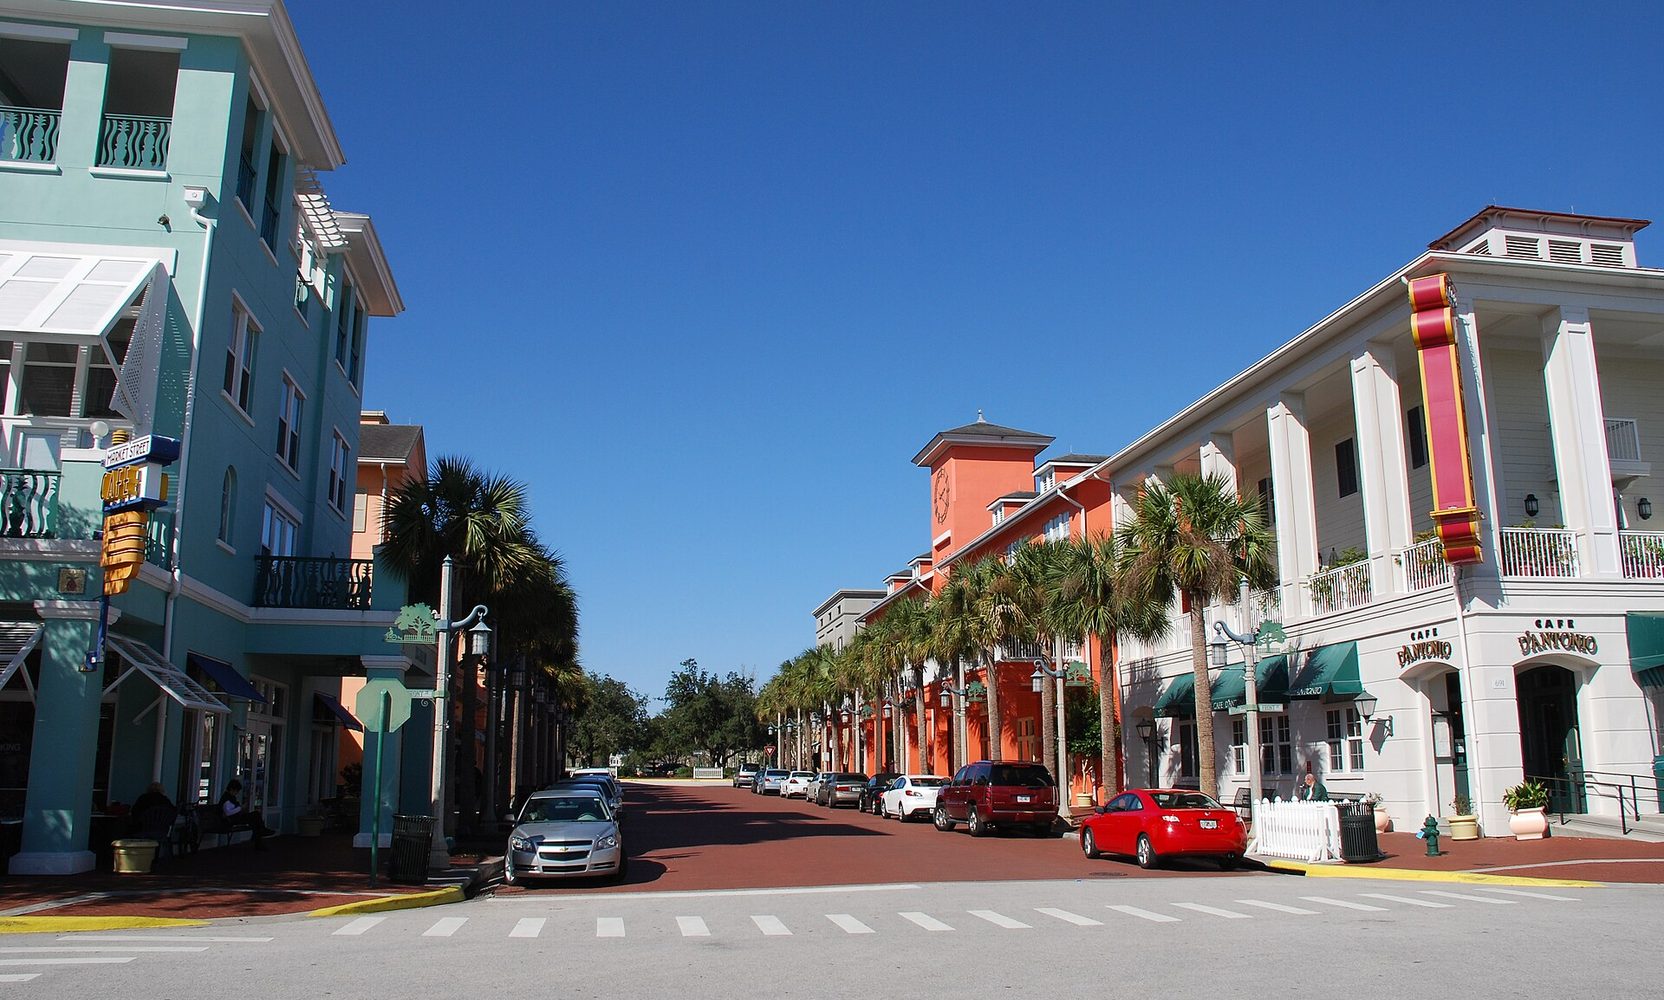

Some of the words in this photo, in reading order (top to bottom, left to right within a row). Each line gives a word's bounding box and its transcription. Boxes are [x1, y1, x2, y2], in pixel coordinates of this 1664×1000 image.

[107, 447, 129, 466] MARKET
[130, 440, 150, 457] STREET
[1410, 627, 1438, 641] CAFE
[1535, 619, 1575, 629] CAFE
[1397, 640, 1452, 668] D'ANTONIO
[1518, 631, 1598, 656] D'ANTONIO
